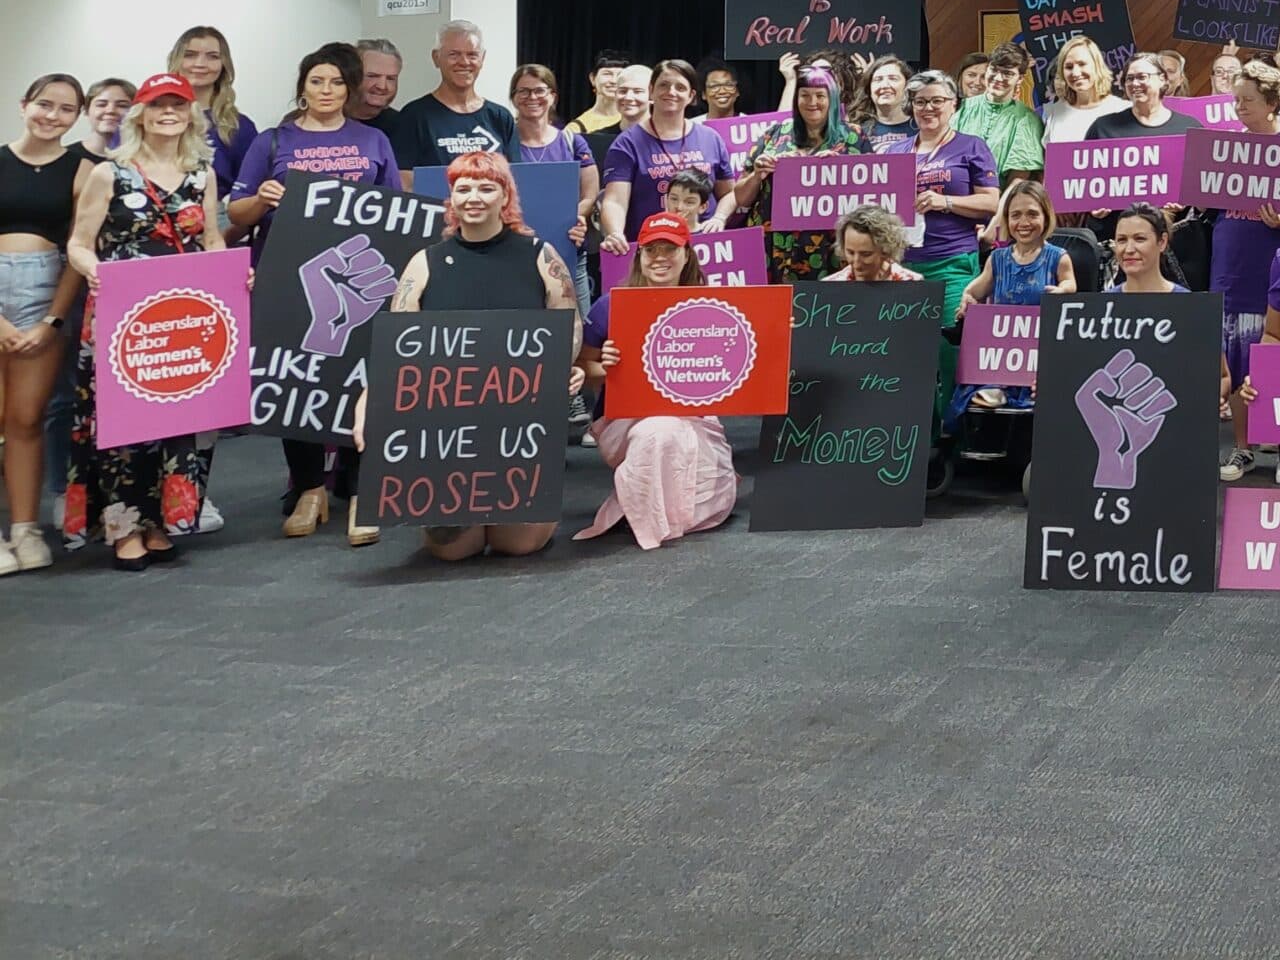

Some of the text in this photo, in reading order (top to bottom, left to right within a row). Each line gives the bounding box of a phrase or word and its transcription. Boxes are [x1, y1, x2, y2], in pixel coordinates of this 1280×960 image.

[1028, 3, 1105, 31] SMASH
[744, 15, 893, 47] Real Work
[1245, 24, 1279, 48] LIKE
[293, 145, 360, 158] UNION
[437, 137, 489, 146] SERVICES
[446, 145, 482, 154] UNION
[287, 157, 370, 170] WOMEN
[1073, 145, 1160, 169] UNION
[801, 163, 889, 187] UNION
[1063, 173, 1168, 199] WOMEN
[304, 179, 447, 237] FIGHT
[649, 218, 681, 228] Labor
[792, 293, 941, 328] She works
[1056, 302, 1177, 343] Future
[130, 312, 217, 336] Queensland
[661, 324, 738, 338] Queensland
[126, 336, 170, 352] Labor
[395, 326, 552, 358] GIVE US
[657, 341, 695, 353] Labor
[830, 336, 889, 356] hard
[126, 346, 203, 368] Women's
[249, 346, 369, 388] LIKE A
[657, 355, 723, 369] Women's
[136, 358, 212, 382] Network
[665, 370, 731, 383] Network
[394, 362, 543, 413] BREAD!
[860, 373, 900, 393] the
[251, 382, 354, 436] GIRL
[383, 423, 547, 463] GIVE US
[773, 414, 919, 486] Money
[377, 464, 541, 518] ROSES!
[1094, 491, 1131, 524] is
[1041, 526, 1192, 585] Female
